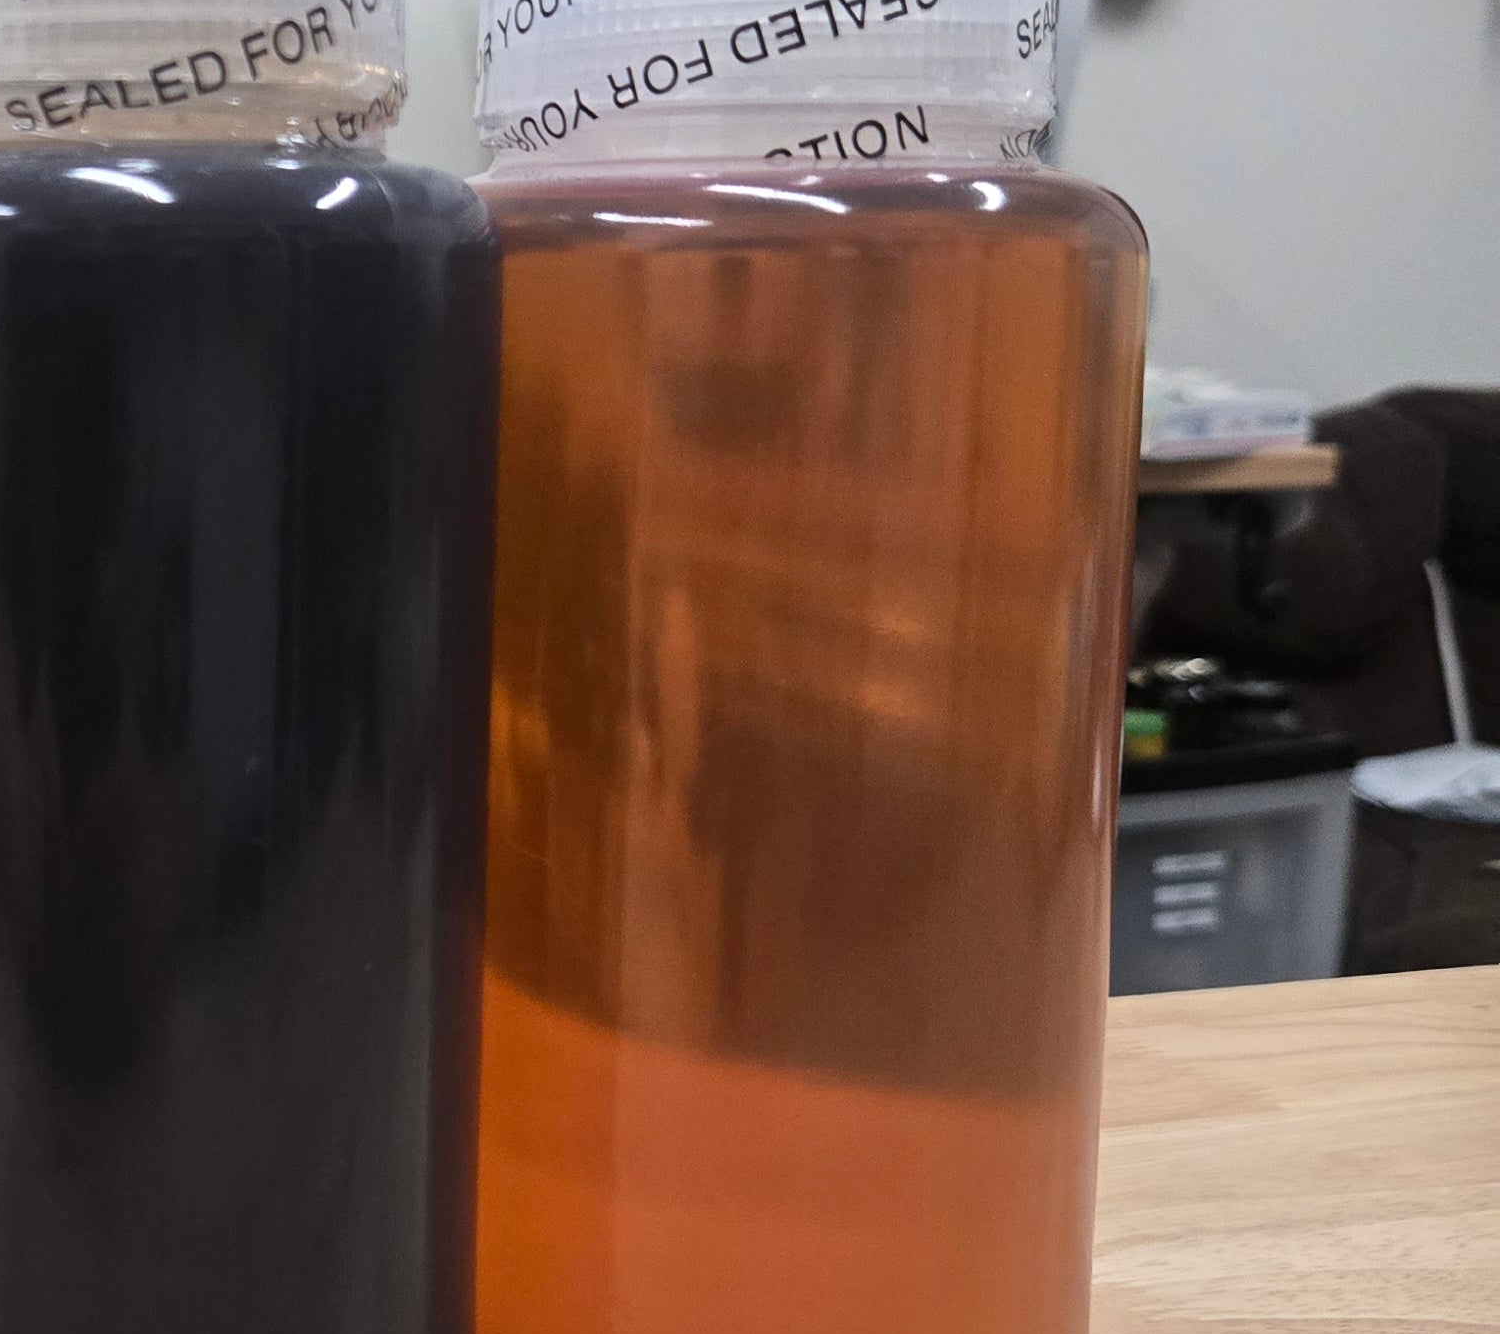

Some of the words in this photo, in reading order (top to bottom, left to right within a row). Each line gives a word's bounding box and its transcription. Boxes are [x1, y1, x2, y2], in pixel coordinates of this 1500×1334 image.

[6, 51, 228, 132] SEALED
[241, 5, 336, 81] FOR
[607, 39, 714, 110] FOR
[764, 105, 930, 159] TION
